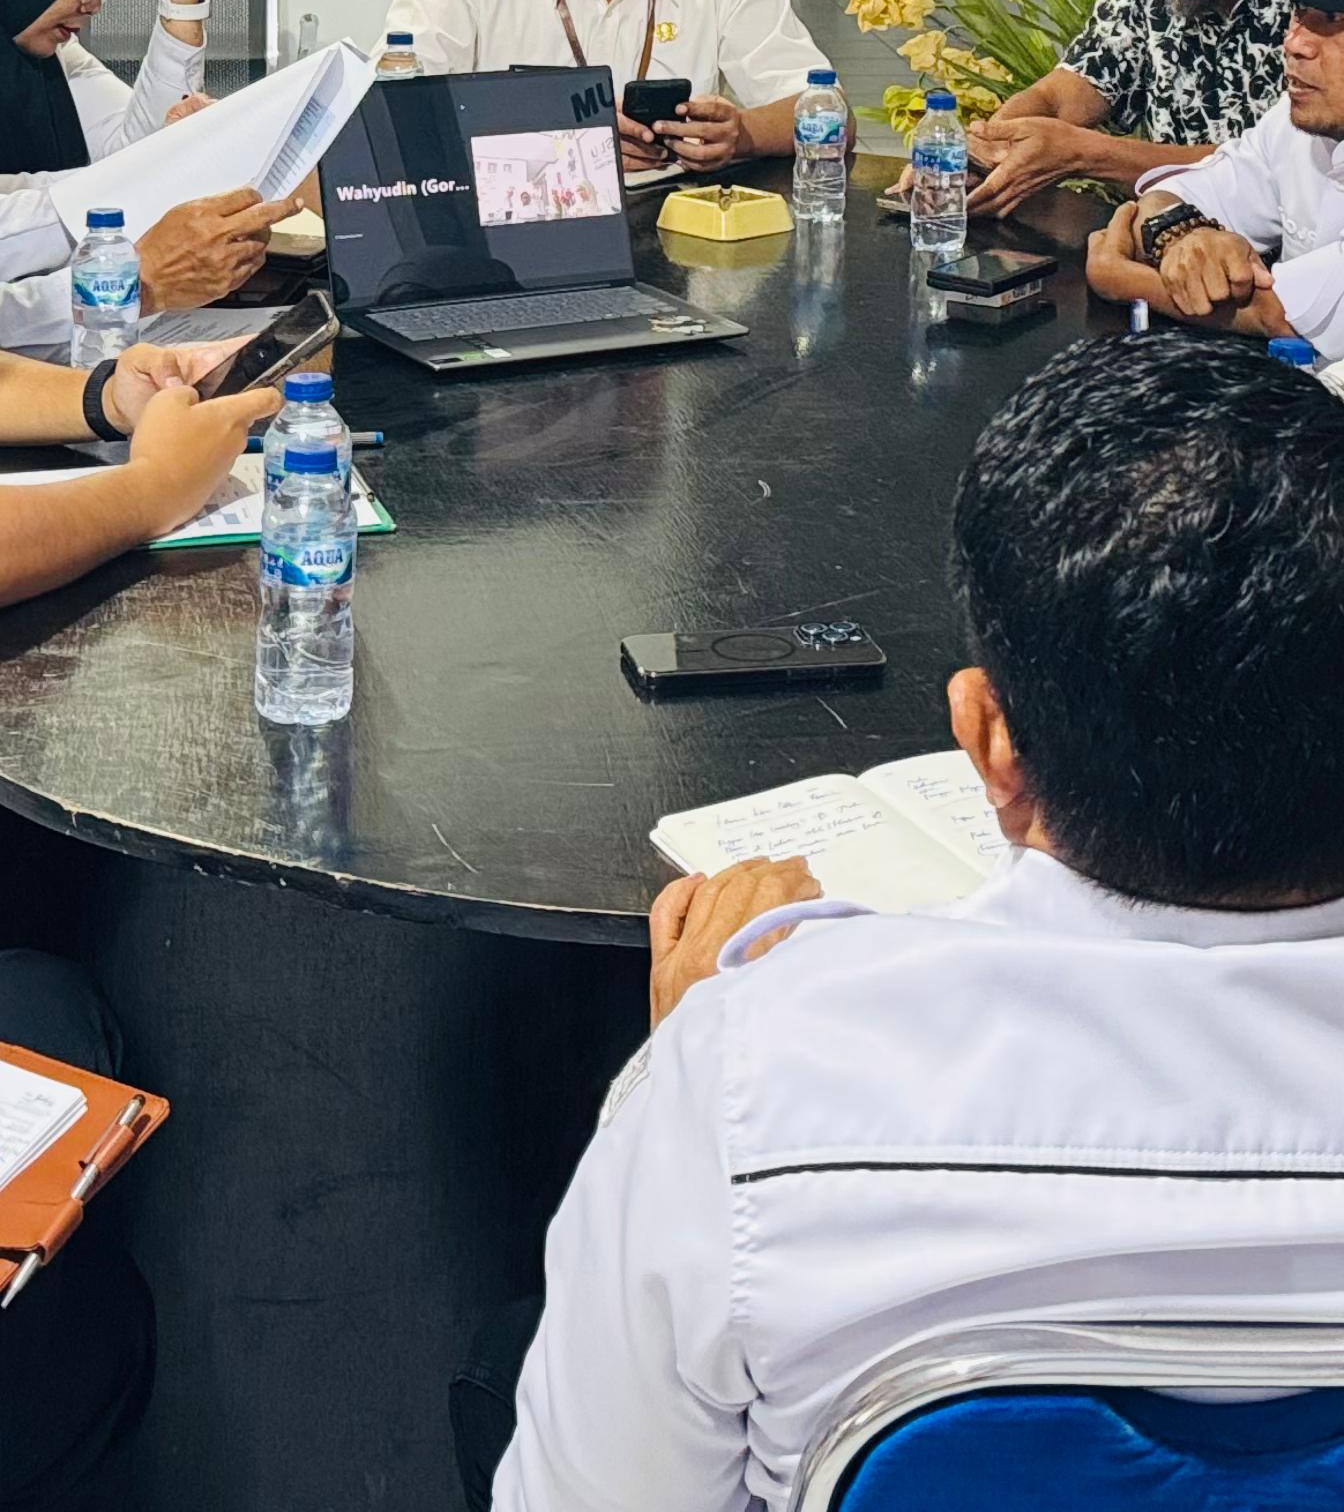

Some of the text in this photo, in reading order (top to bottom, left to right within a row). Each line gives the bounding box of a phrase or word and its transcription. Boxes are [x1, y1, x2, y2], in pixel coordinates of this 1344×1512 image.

[337, 181, 417, 204] Wahyudin
[93, 279, 125, 292] AQUA
[301, 548, 344, 567] AQUA
